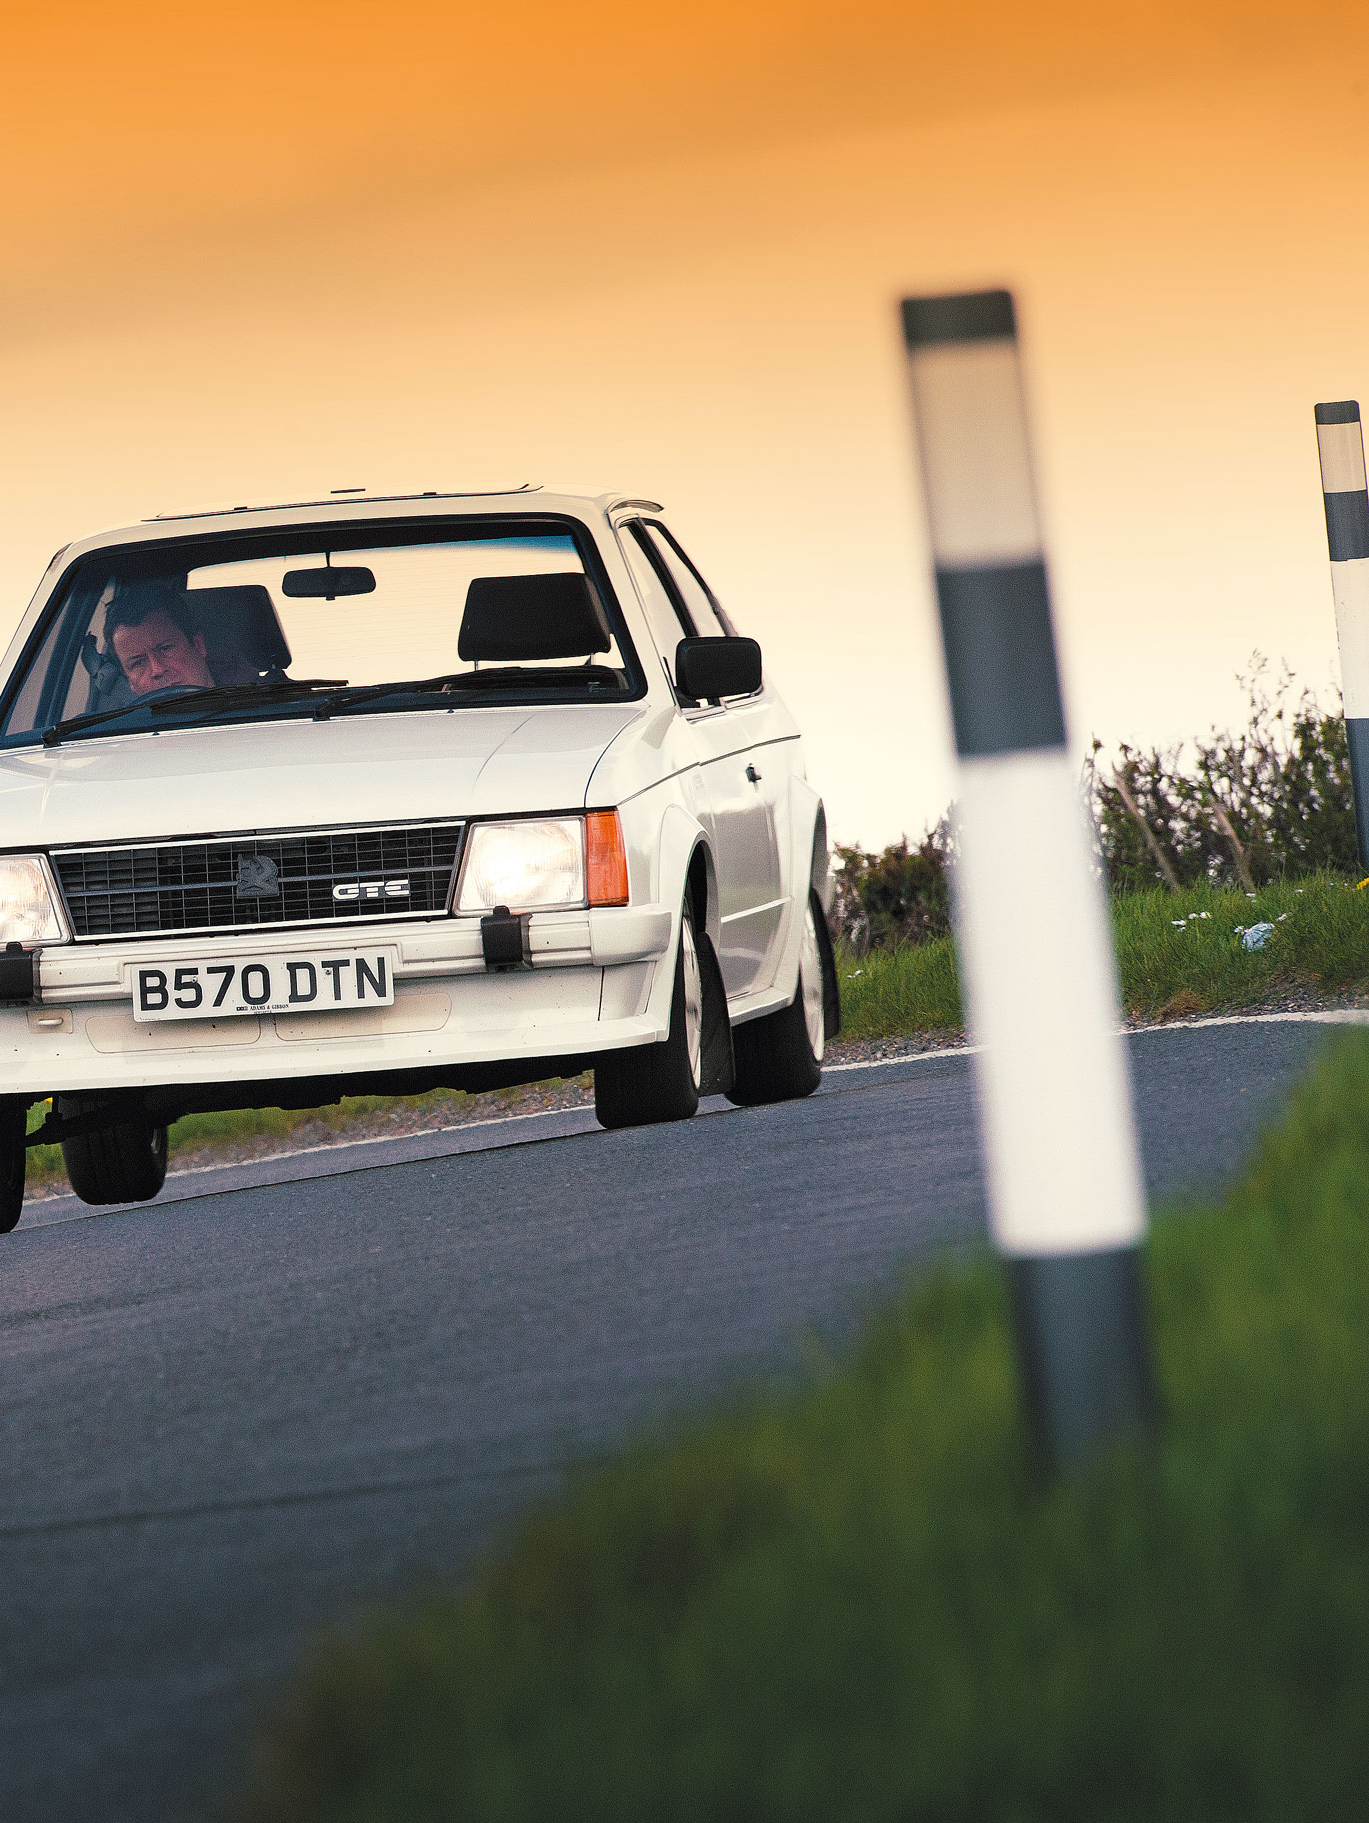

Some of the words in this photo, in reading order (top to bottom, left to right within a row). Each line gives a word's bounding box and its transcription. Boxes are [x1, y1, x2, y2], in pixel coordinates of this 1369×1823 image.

[332, 879, 410, 900] GTE
[138, 963, 272, 1011] B570
[285, 956, 388, 1004] DTN
